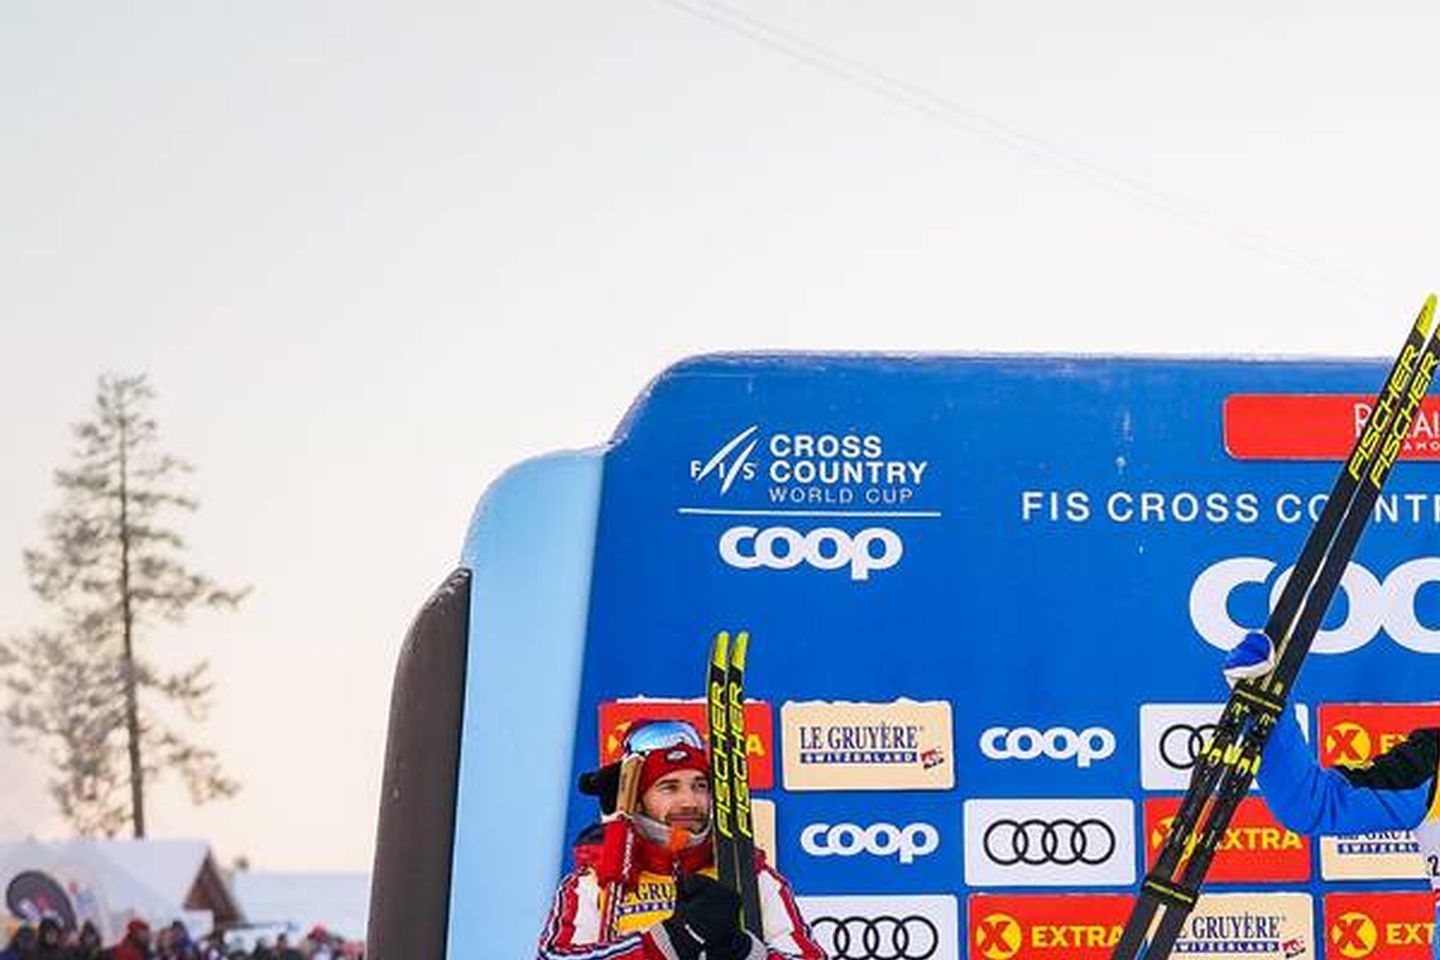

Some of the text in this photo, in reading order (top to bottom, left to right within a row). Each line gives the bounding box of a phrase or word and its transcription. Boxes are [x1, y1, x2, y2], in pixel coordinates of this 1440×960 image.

[1348, 345, 1419, 481] FISCHER
[1354, 403, 1440, 439] RA!
[1370, 352, 1439, 488] FISCHER
[770, 434, 881, 457] CROSS
[770, 461, 927, 484] COUNTRY
[770, 488, 913, 504] WORLD CUP
[1022, 492, 1090, 521] FIS
[1108, 493, 1258, 522] CROSS
[719, 526, 902, 579] coop
[800, 721, 918, 749] LE GRUYÈRE
[980, 727, 1116, 767] coop
[712, 682, 732, 838] FISCHER
[729, 682, 752, 838] FISCHER
[802, 752, 917, 763] SWITZERLAND
[800, 823, 939, 863] coop
[1215, 828, 1303, 850] XTRA
[1192, 912, 1280, 938] GRUYÈRE
